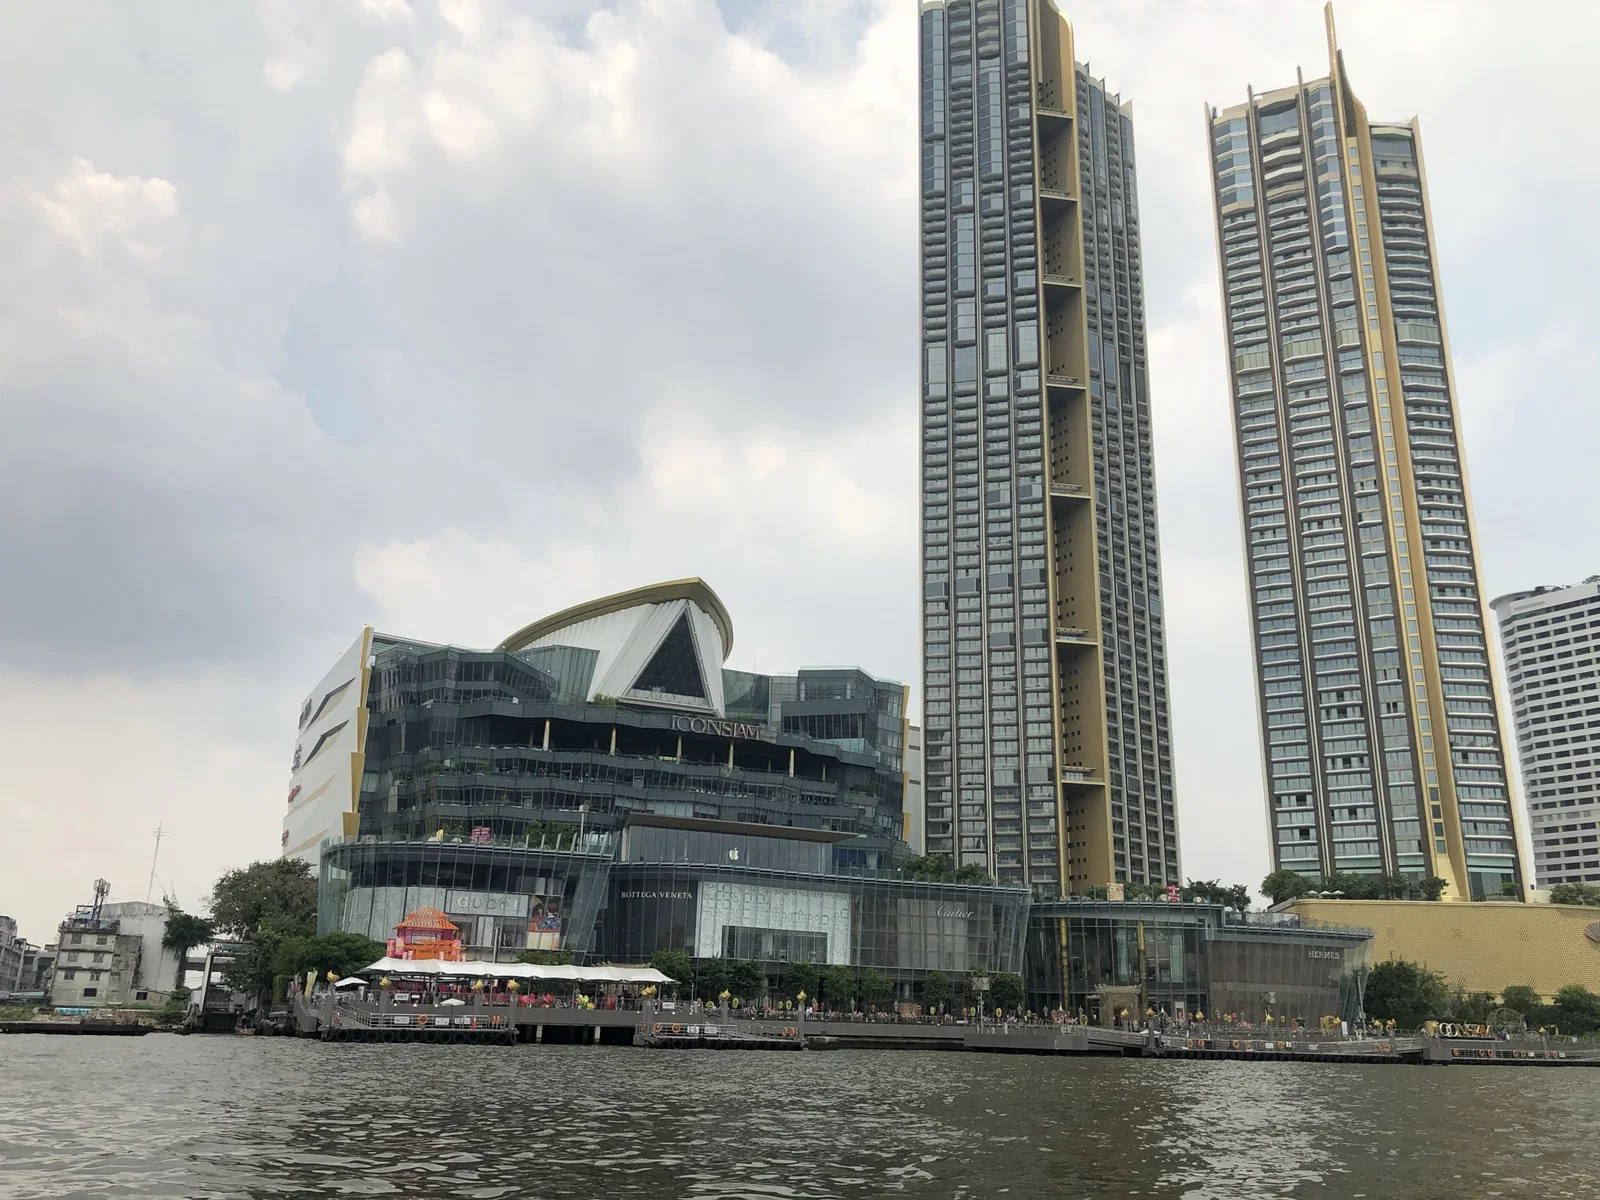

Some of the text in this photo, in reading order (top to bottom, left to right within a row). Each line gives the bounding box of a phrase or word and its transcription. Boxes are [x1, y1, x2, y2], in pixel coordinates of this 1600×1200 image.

[670, 714, 760, 740] ICONSIAM
[621, 891, 693, 899] BOTTEGA VENETA
[457, 896, 518, 911] GUCCI
[936, 904, 974, 918] Cartier
